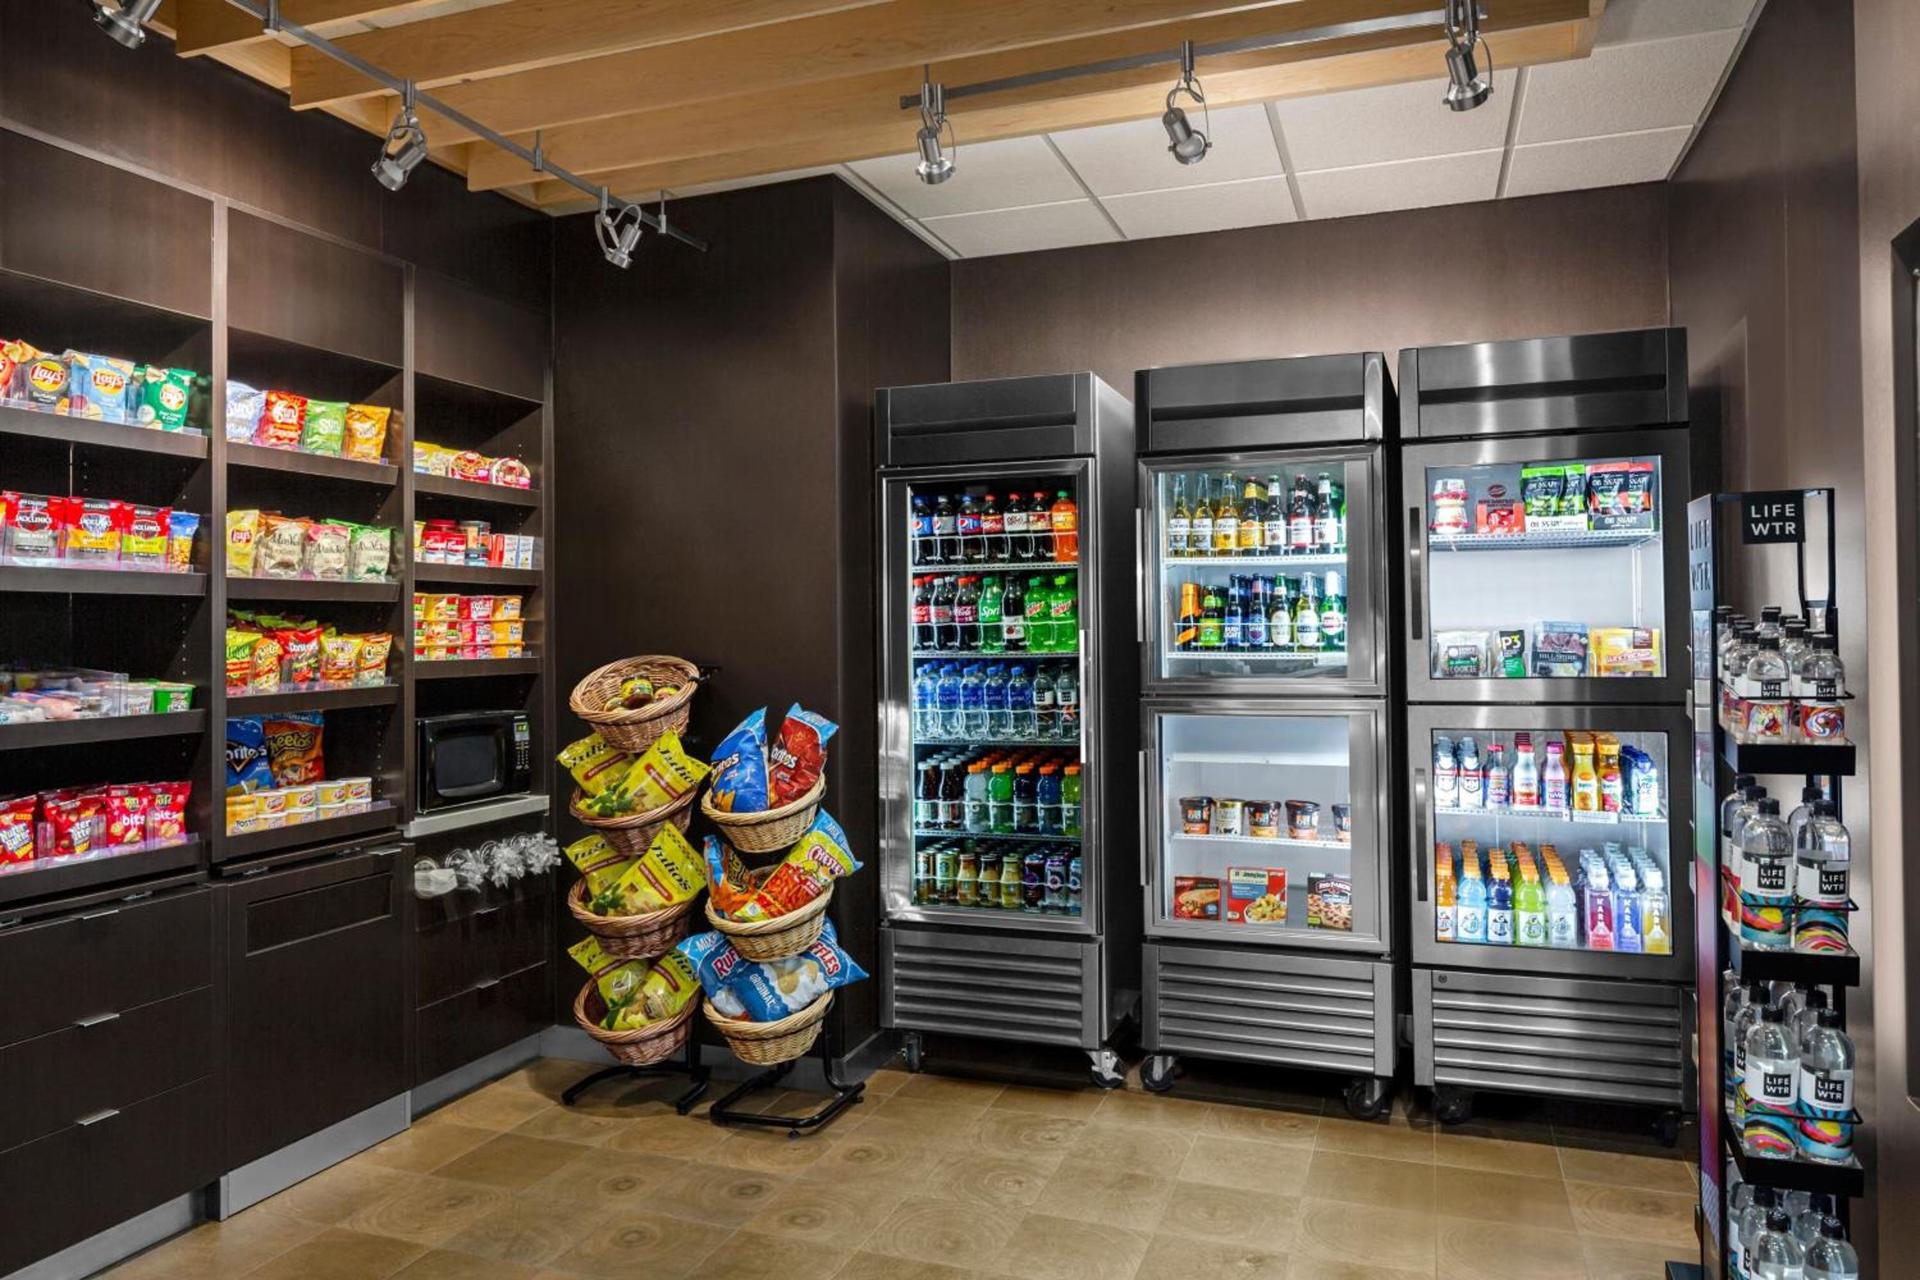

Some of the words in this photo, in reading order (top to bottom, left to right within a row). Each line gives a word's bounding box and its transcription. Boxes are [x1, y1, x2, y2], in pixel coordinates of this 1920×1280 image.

[33, 364, 65, 383] Lay's
[94, 371, 125, 387] Lay's
[1751, 504, 1796, 518] LIFE
[1751, 522, 1796, 536] WTR
[981, 605, 1000, 617] Spri
[1501, 635, 1521, 649] P3
[1818, 686, 1836, 694] LIFE
[122, 813, 145, 826] bits
[651, 845, 691, 892] Julio's
[1760, 869, 1784, 877] LIFE
[1822, 883, 1845, 891] WTR
[810, 941, 840, 977] FFLES
[1766, 1076, 1789, 1085] LIFE
[1818, 1080, 1842, 1092] LIFE
[1766, 1085, 1789, 1094] WTR
[1818, 1090, 1842, 1100] WTR
